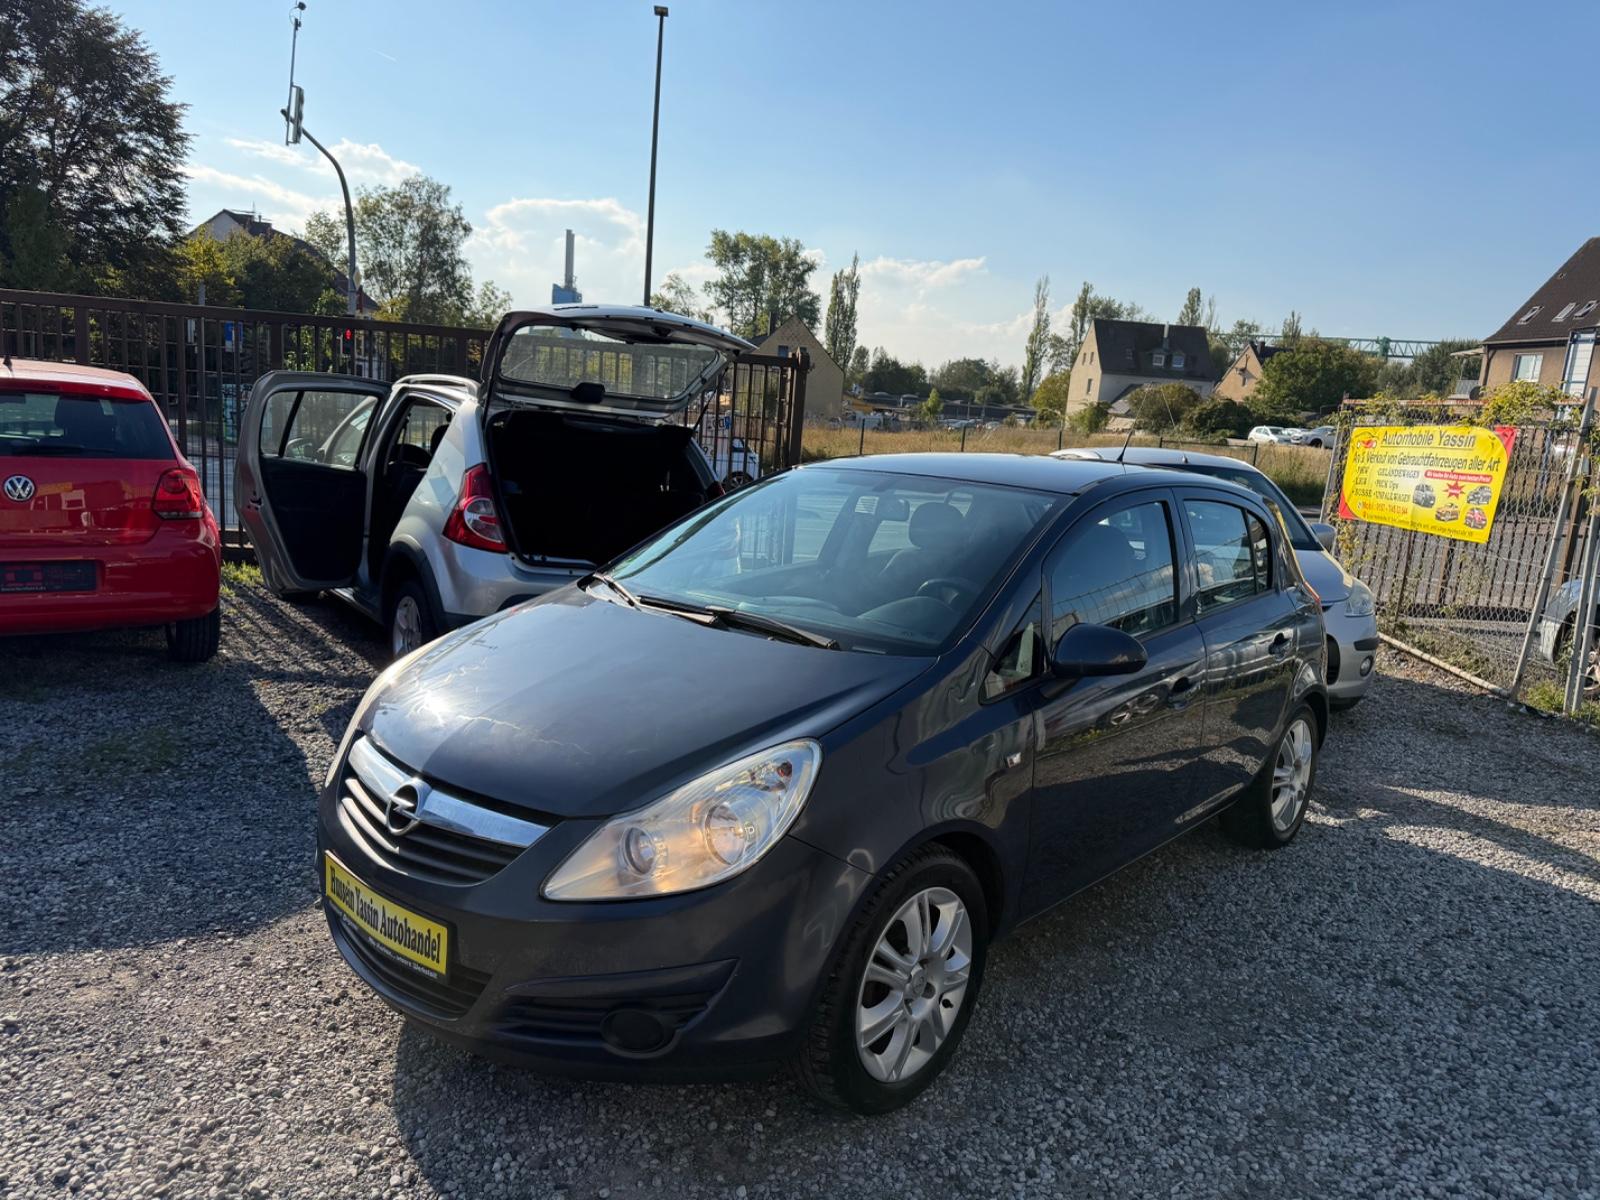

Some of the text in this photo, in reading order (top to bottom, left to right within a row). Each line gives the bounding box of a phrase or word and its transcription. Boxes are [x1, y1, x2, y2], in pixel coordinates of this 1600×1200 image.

[1381, 430, 1476, 448] Automobile Yassin
[1398, 452, 1467, 471] Gebrauchtfahrzeugen
[1468, 456, 1485, 470] aller
[1486, 457, 1501, 472] Art
[355, 886, 380, 932] Yassin
[380, 905, 441, 964] Autohandel
